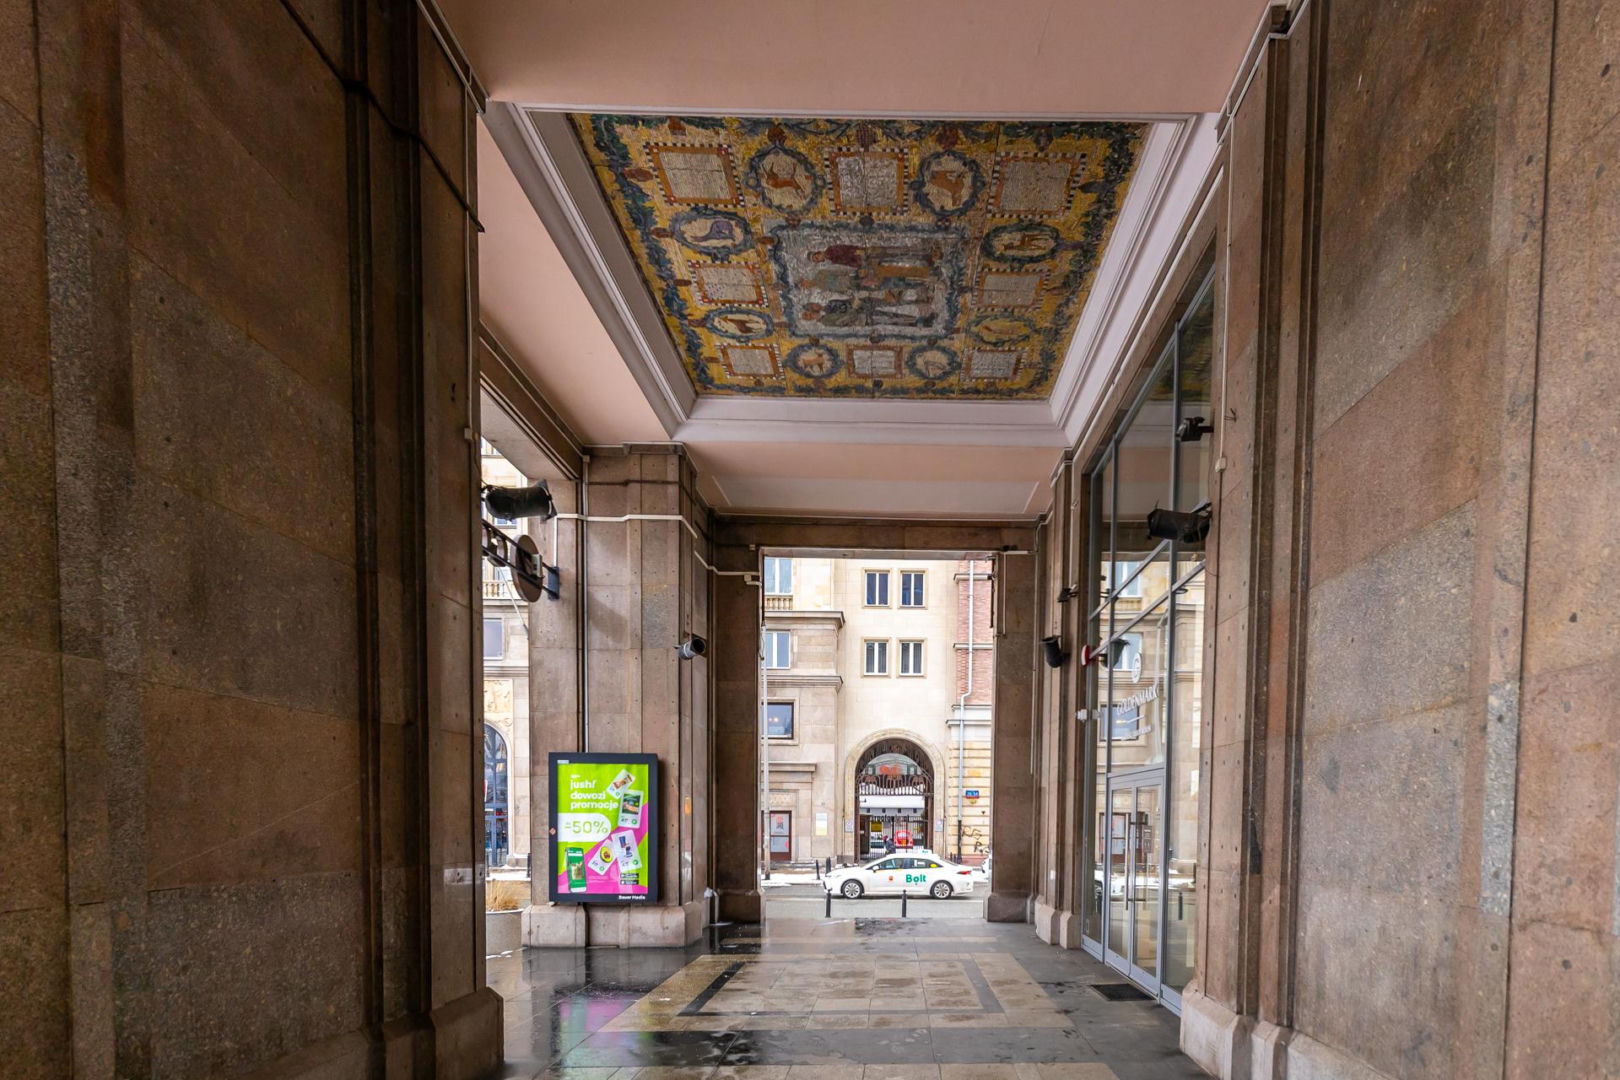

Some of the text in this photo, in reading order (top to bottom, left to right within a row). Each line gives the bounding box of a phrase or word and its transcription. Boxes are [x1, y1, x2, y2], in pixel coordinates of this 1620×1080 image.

[570, 791, 606, 800] dowozi
[570, 800, 619, 811] promocje
[905, 873, 927, 883] Bolt
